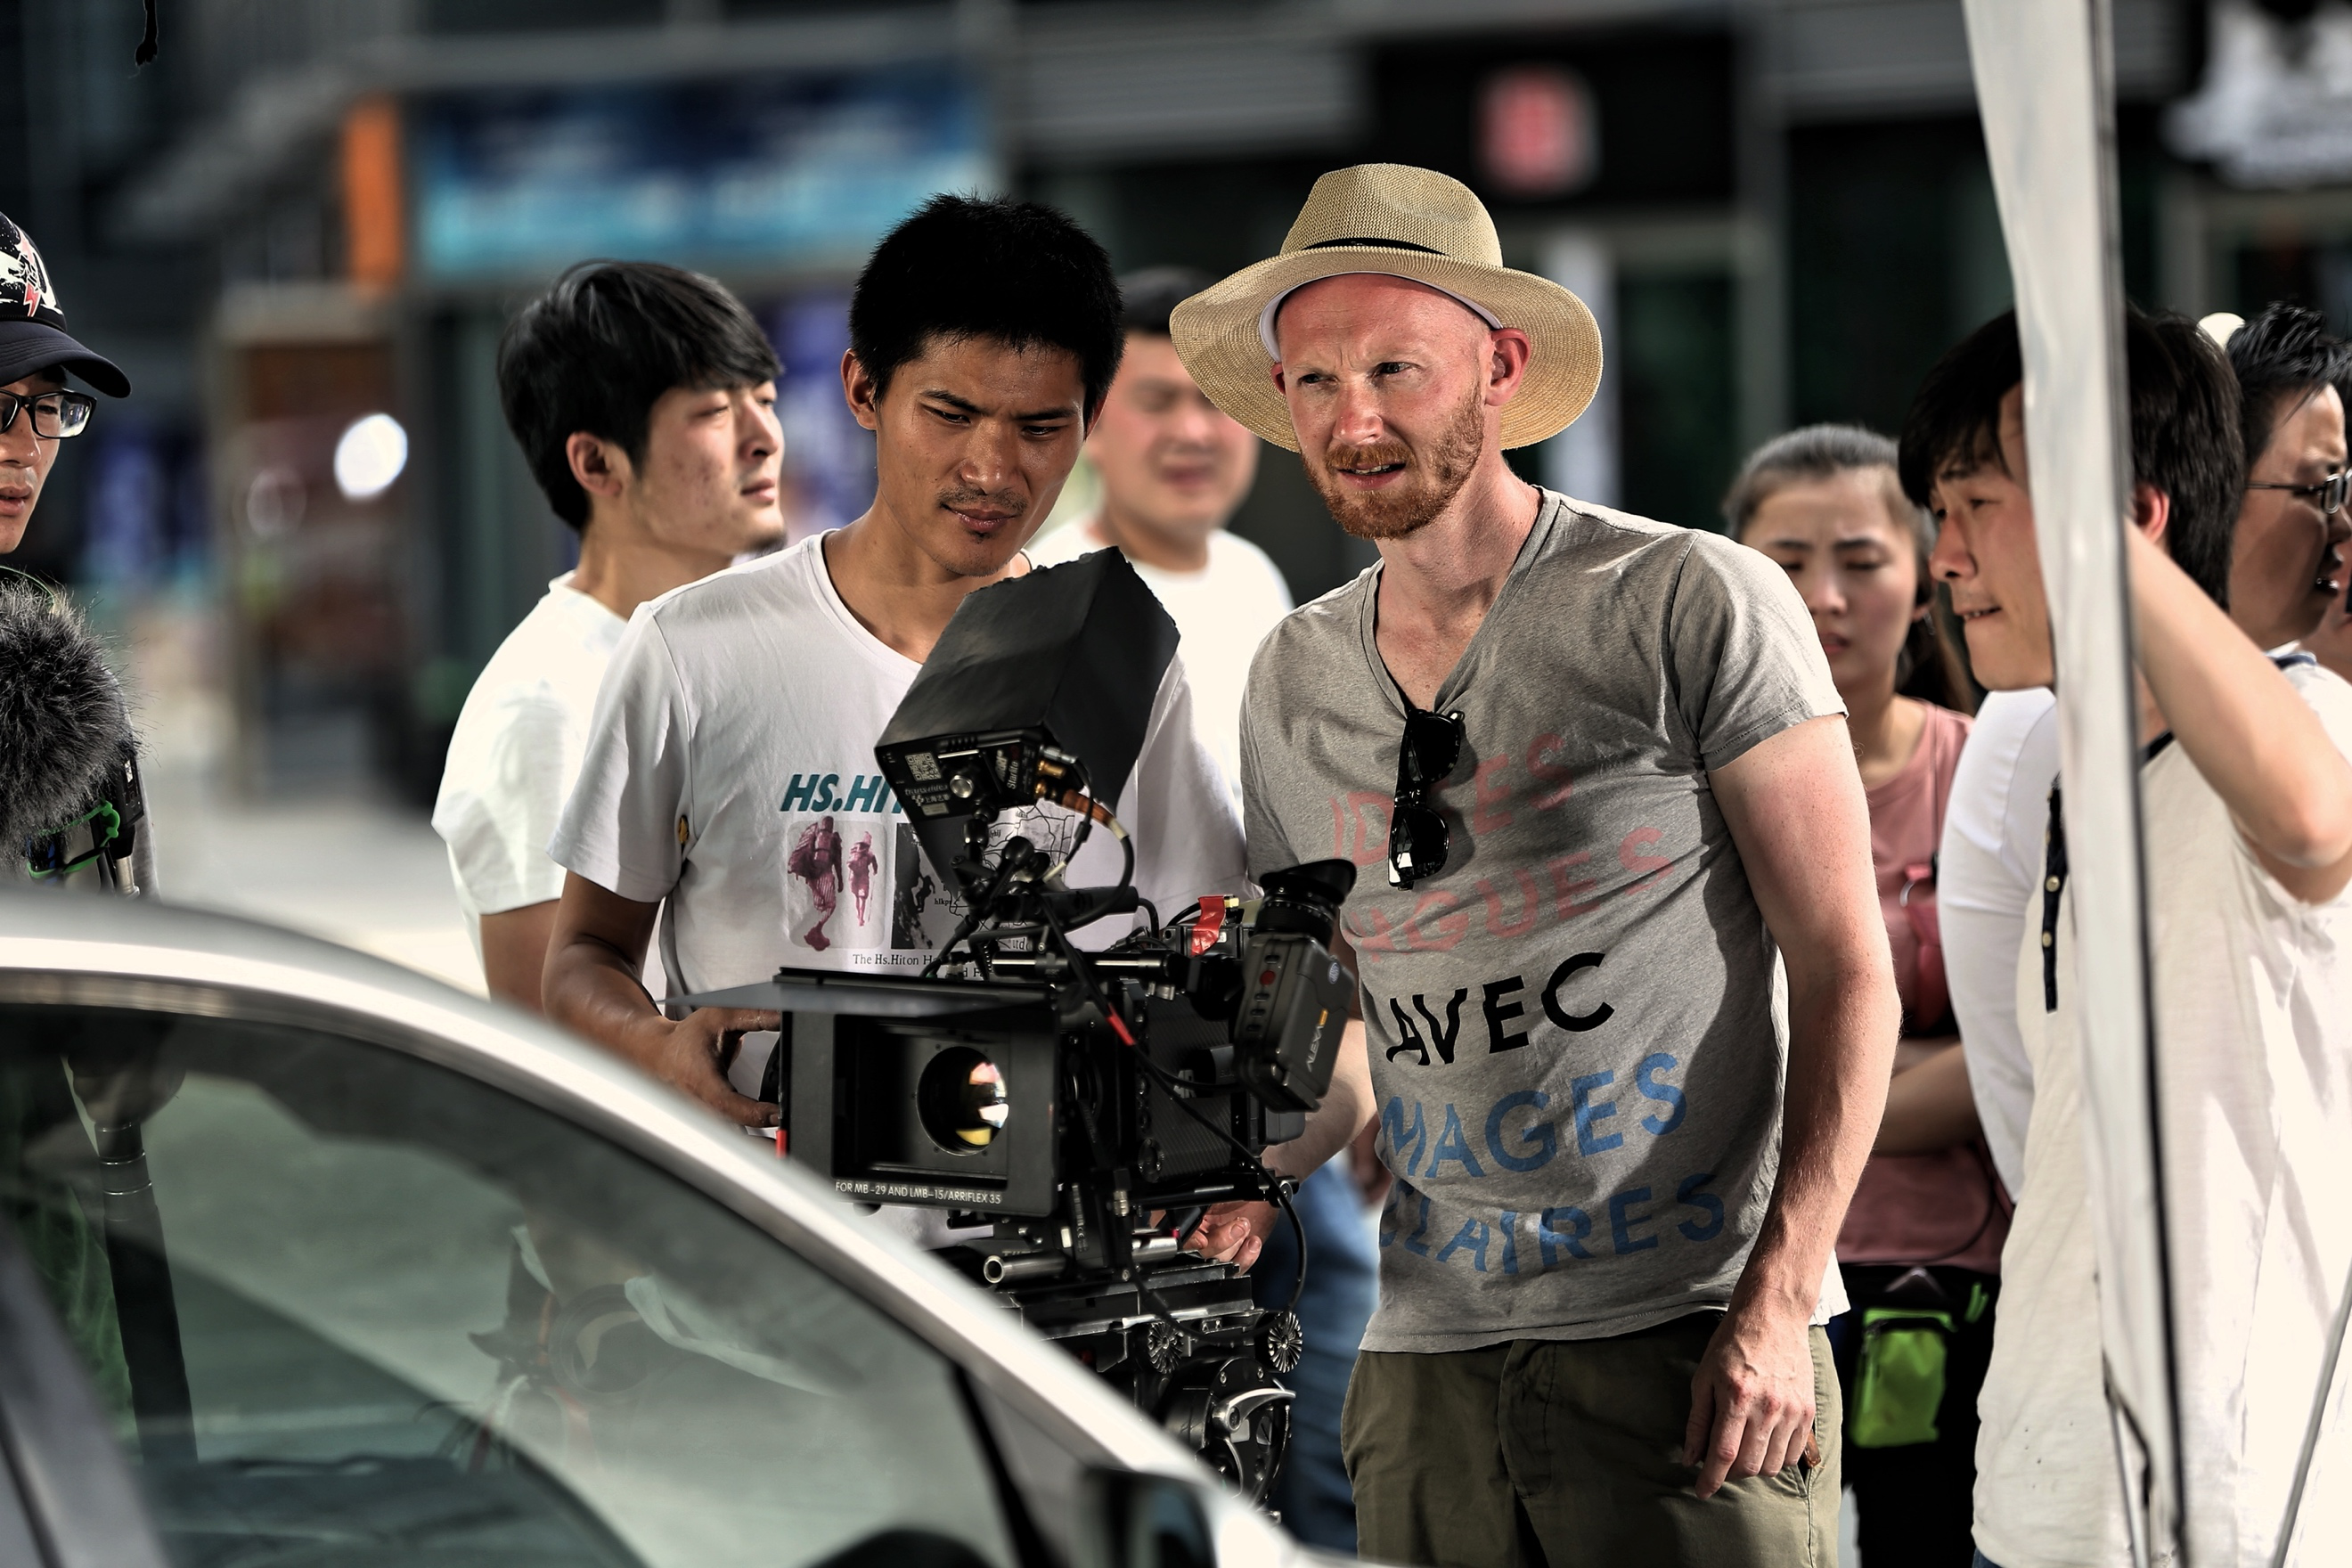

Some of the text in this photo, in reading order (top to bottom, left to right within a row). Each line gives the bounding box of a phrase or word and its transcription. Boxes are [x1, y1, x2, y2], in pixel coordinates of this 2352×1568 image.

[780, 773, 902, 813] HS.HI
[1328, 733, 1574, 867] IDES
[853, 954, 872, 965] The
[874, 954, 919, 966] Hs.Hiton
[1385, 951, 1615, 1066] AVEC
[1306, 1025, 1324, 1073] ALEXA
[1375, 1052, 1687, 1178] MAGES
[835, 1181, 853, 1192] FOR
[887, 1186, 909, 1197] AND
[989, 1194, 1001, 1205] 35
